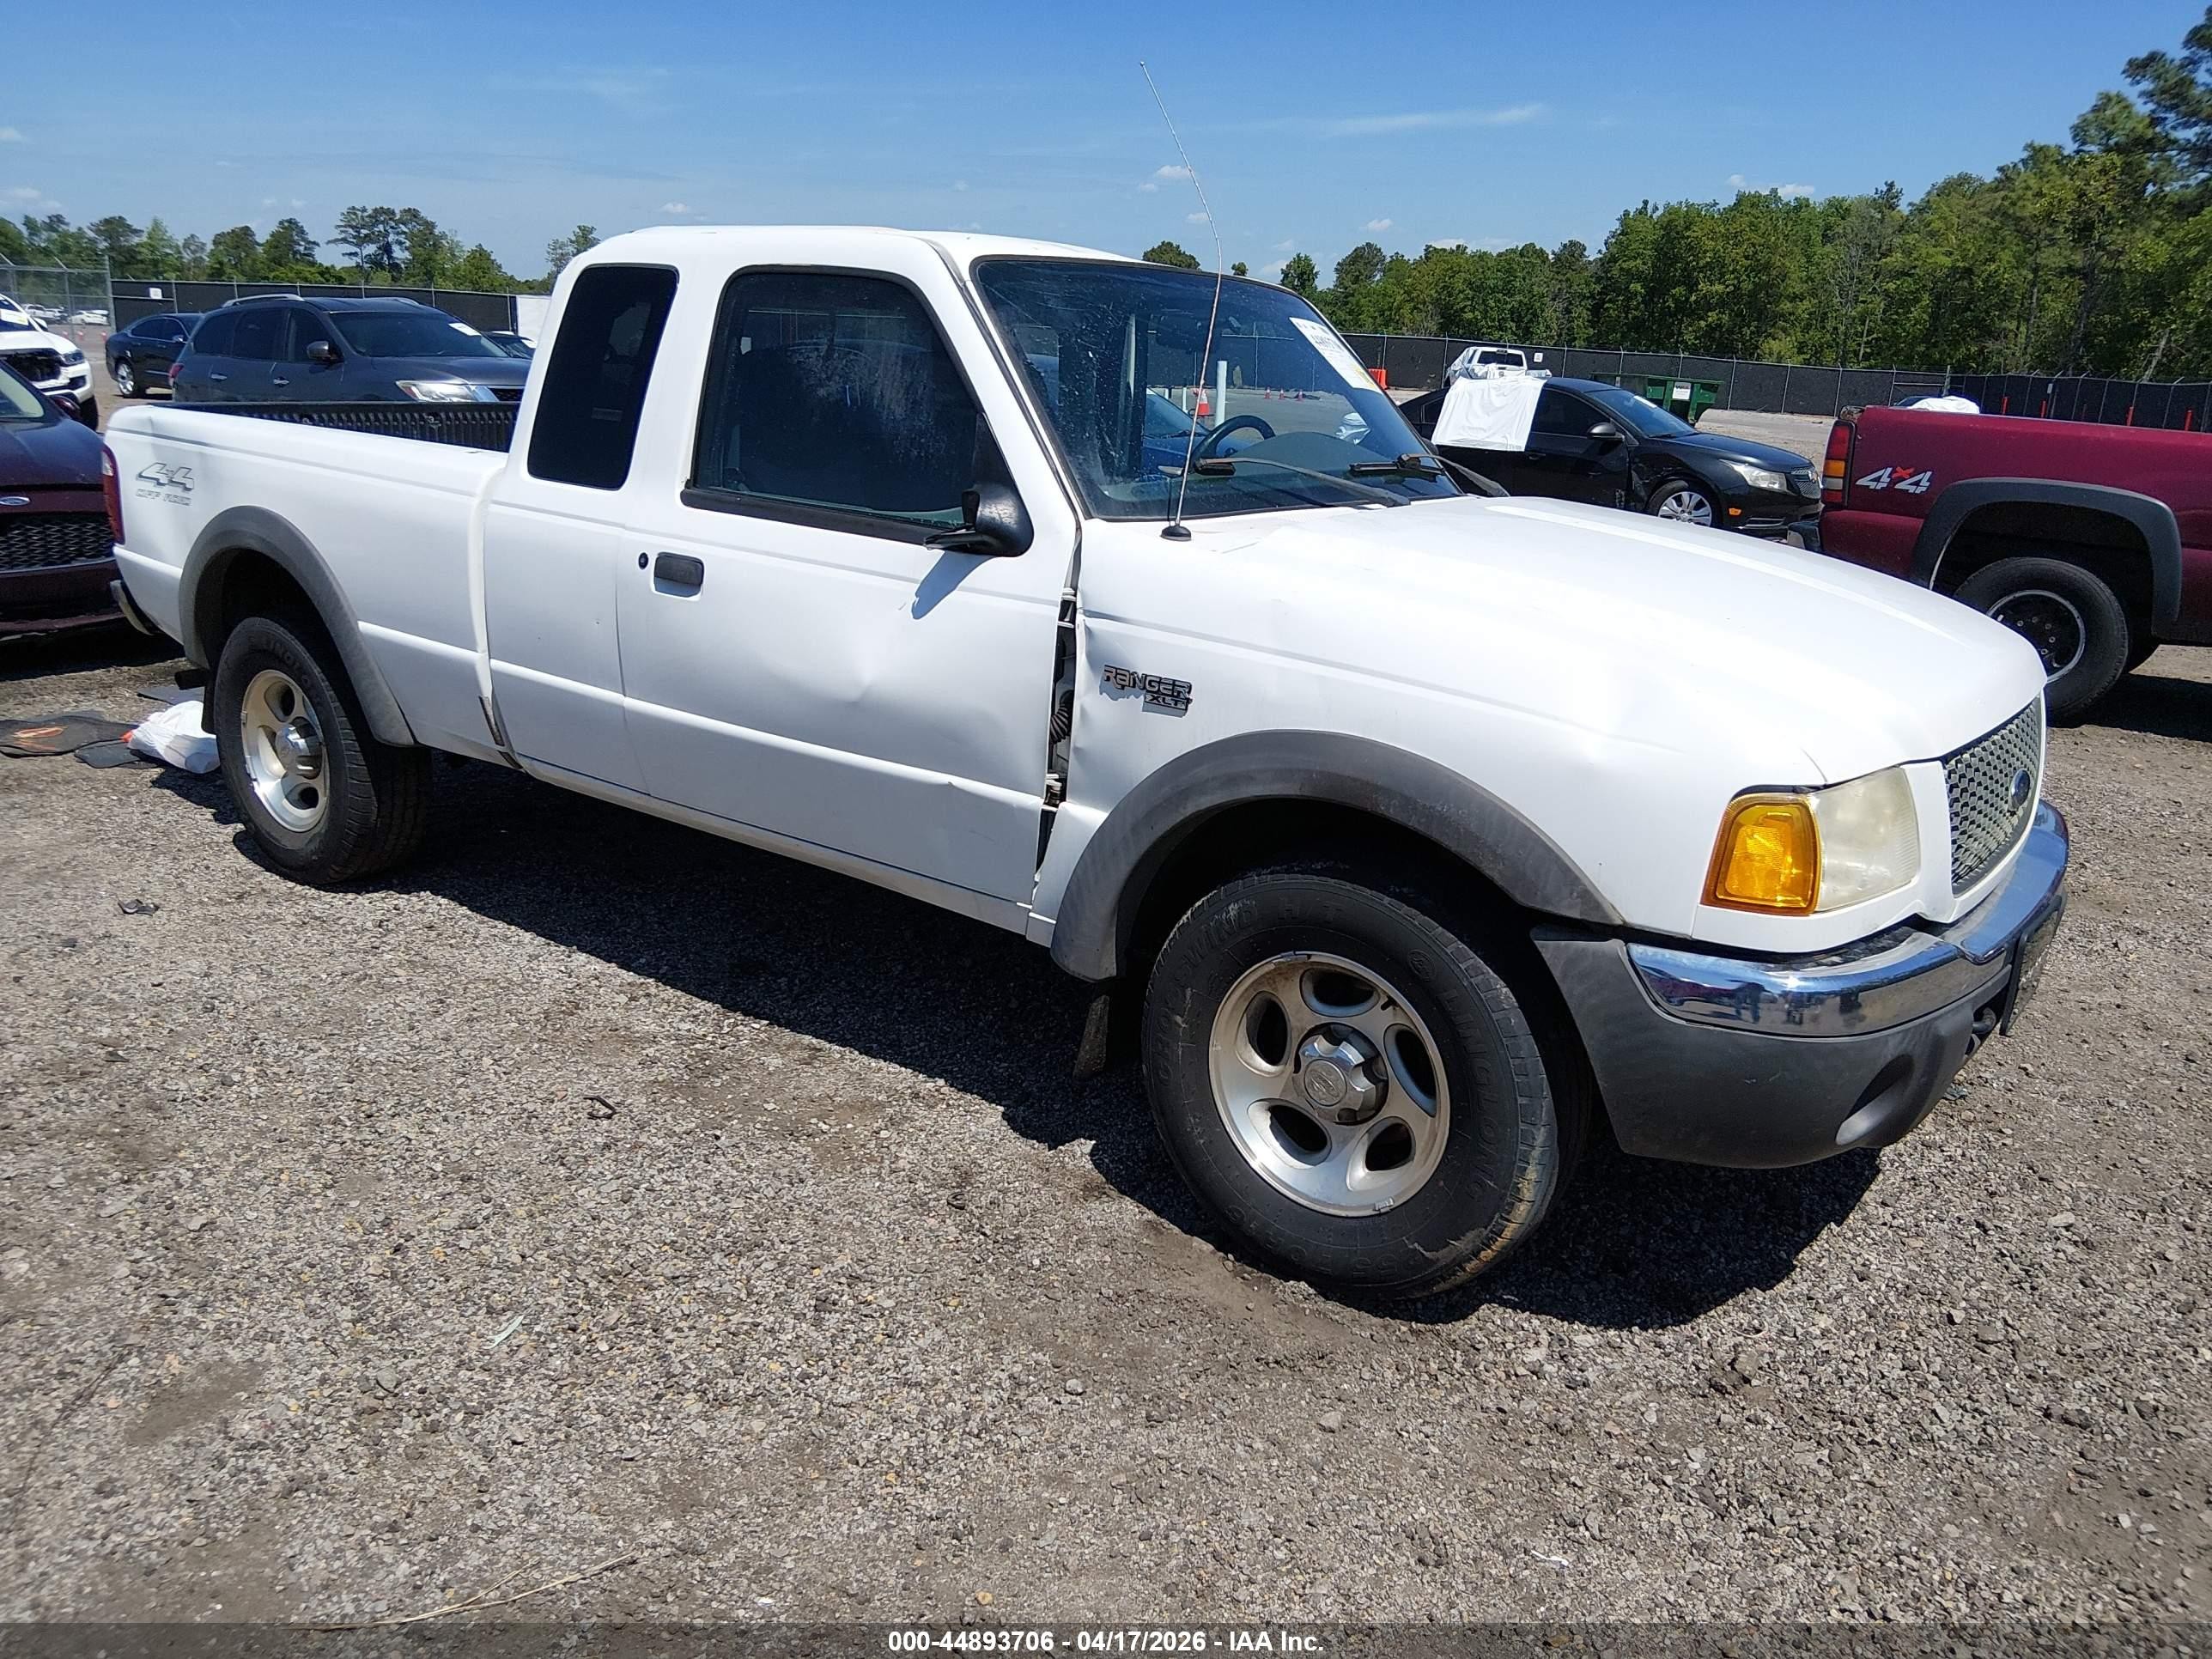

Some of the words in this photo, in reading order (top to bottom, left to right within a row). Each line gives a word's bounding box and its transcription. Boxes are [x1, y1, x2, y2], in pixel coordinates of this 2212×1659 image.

[1103, 665, 1192, 699] RANGER
[1145, 693, 1188, 711] XLT
[1442, 992, 1500, 1201] LINGLONG
